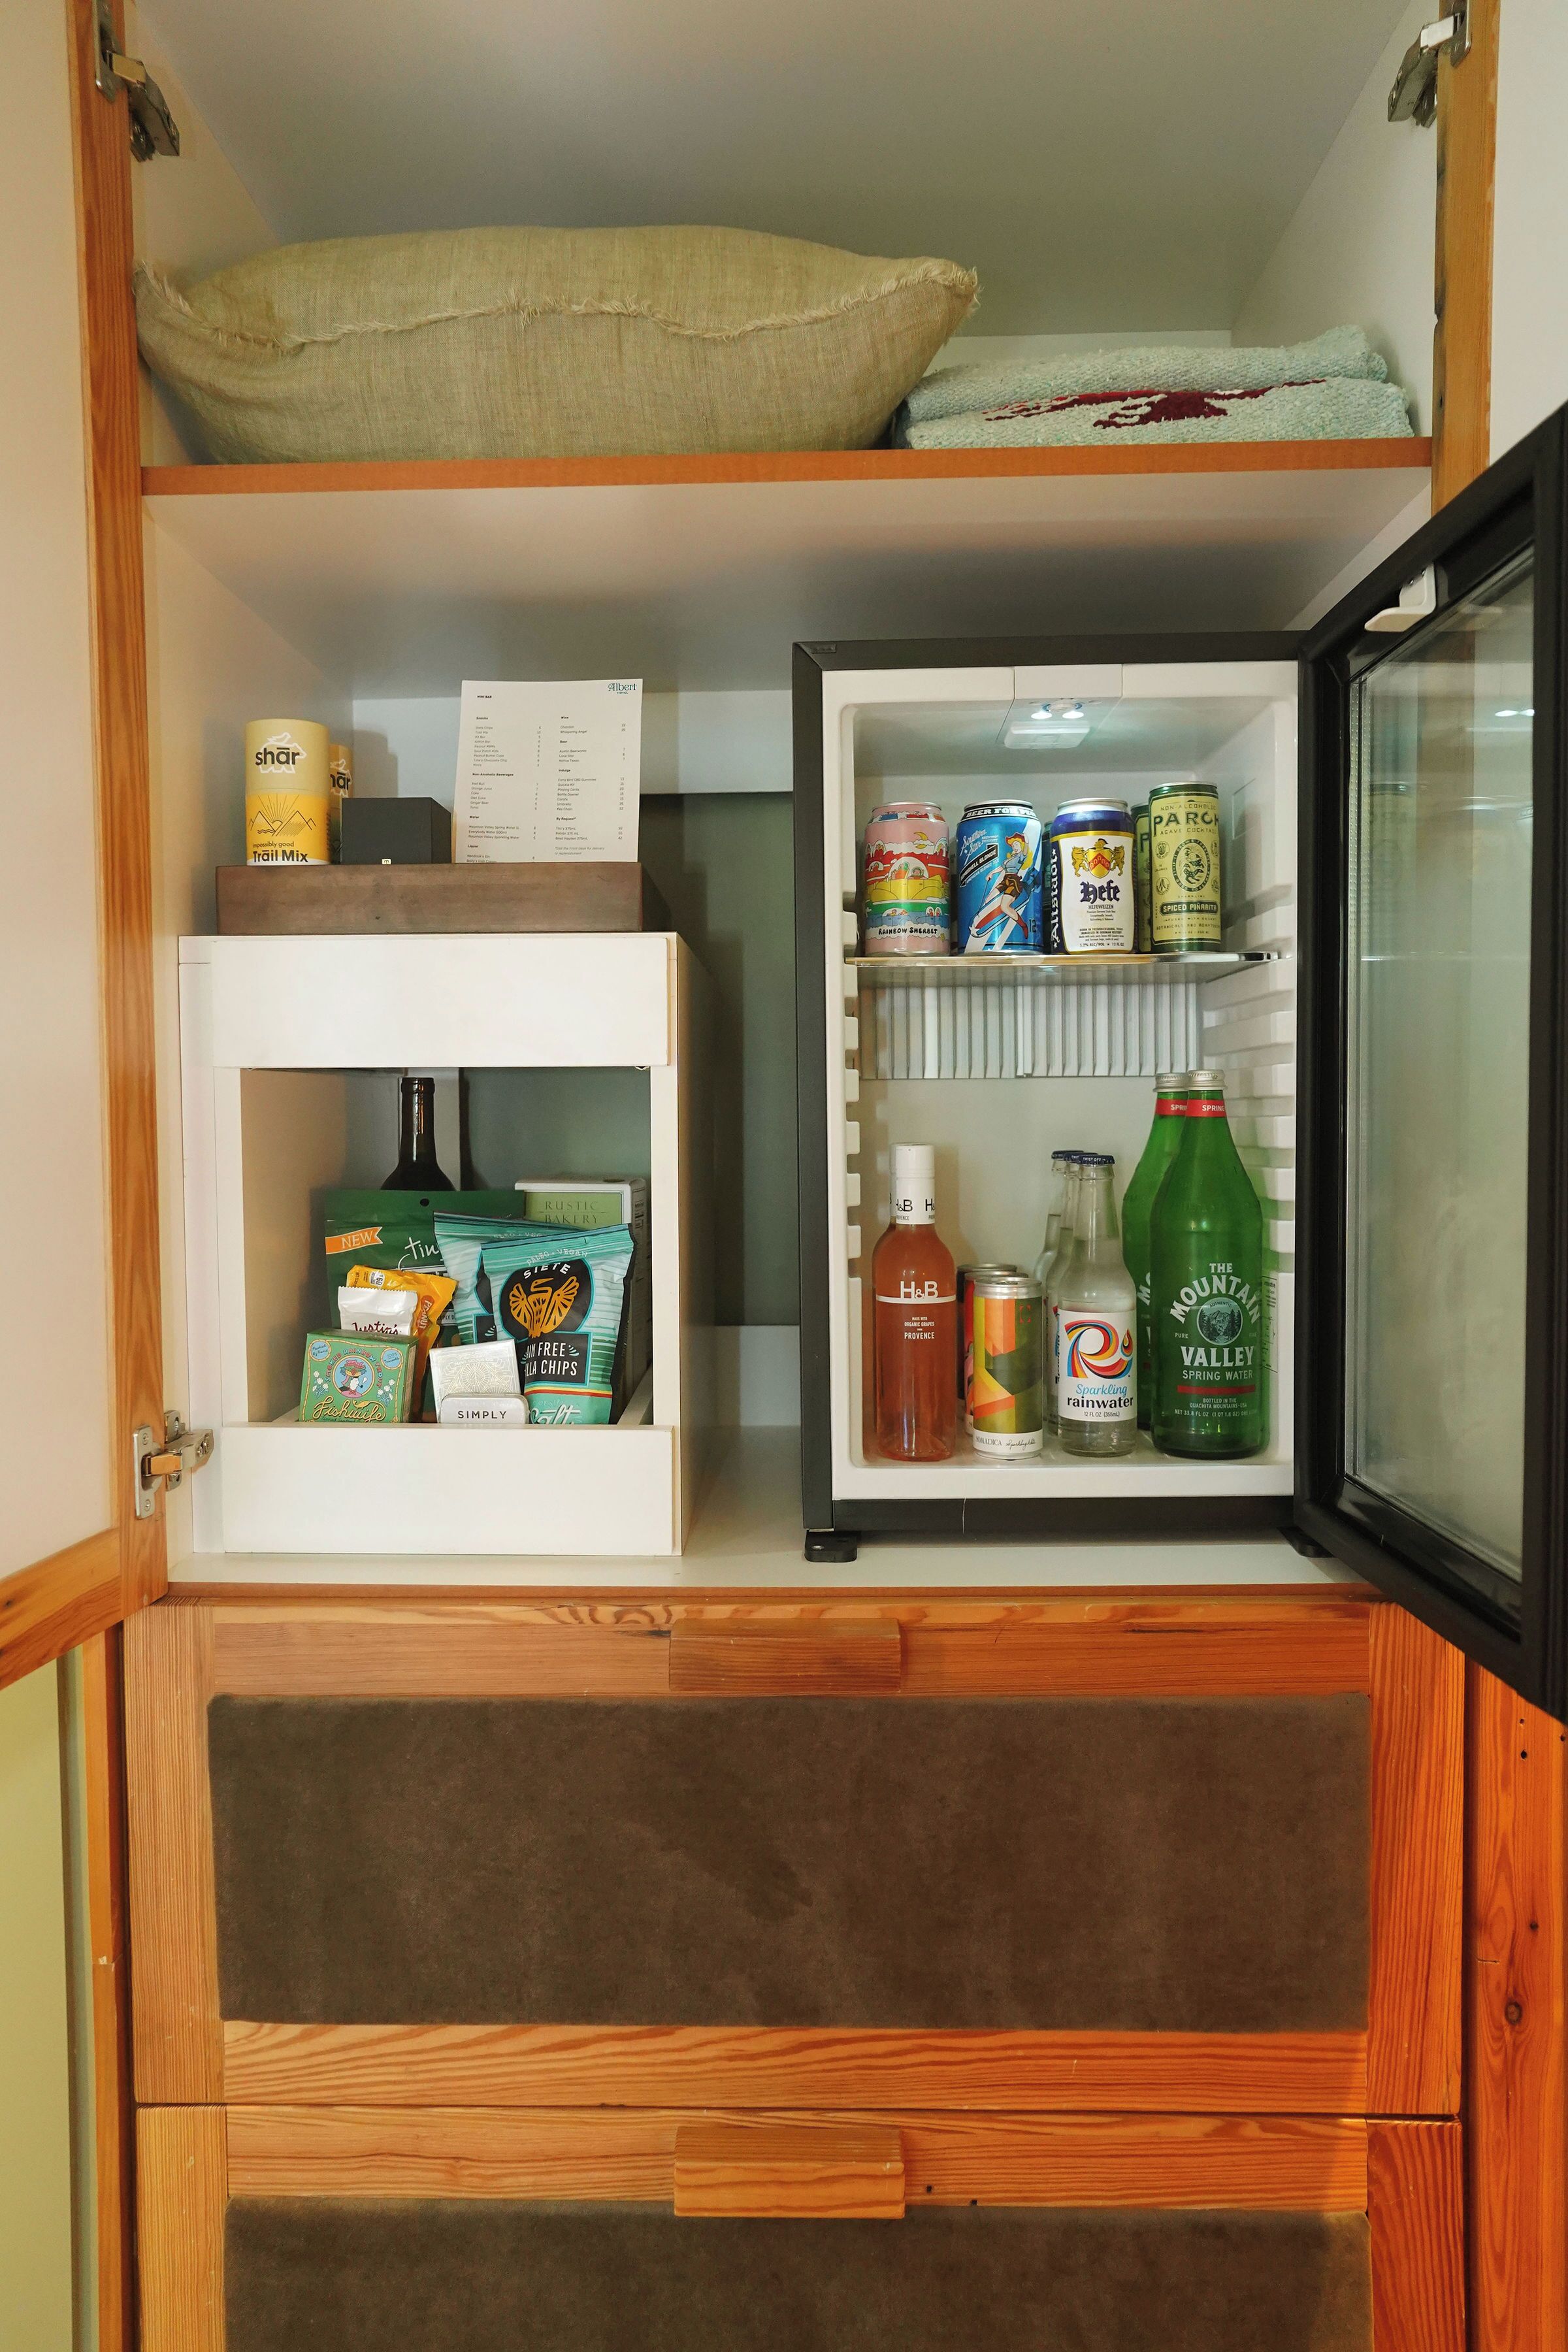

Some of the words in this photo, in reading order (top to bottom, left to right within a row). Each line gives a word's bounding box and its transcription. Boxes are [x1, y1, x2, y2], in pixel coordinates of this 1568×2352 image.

[255, 747, 300, 766] shār
[331, 772, 350, 791] hār
[966, 809, 992, 818] BEER
[253, 850, 278, 863] Trāil
[282, 850, 308, 862] Mix
[979, 849, 996, 864] BLONDE
[1080, 879, 1120, 904] Hefe
[545, 1201, 598, 1210] RUSTIC
[925, 1198, 935, 1212] H&
[545, 1214, 598, 1224] BAKERY
[341, 1231, 373, 1249] NEW
[404, 1237, 440, 1260] tin
[527, 1250, 549, 1266] PALEO
[557, 1249, 588, 1258] VEGAN
[523, 1262, 571, 1279] SIETE
[1209, 1262, 1233, 1273] THE
[900, 1281, 938, 1299] H&B
[1169, 1275, 1260, 1324] MOUNTAIN
[419, 1299, 432, 1329] PEANUT
[526, 1344, 536, 1360] AIN
[538, 1342, 566, 1357] FREE
[1181, 1346, 1254, 1367] VALLEY
[325, 1353, 342, 1382] SMOKED
[343, 1348, 376, 1362] RAINBOW
[541, 1360, 578, 1376] CHIPS
[1183, 1370, 1220, 1380] SPRING
[1226, 1369, 1253, 1380] WATER
[1076, 1384, 1127, 1397] Sparkling
[313, 1396, 385, 1422] Fishwife
[1068, 1396, 1134, 1409] rainwater
[457, 1411, 508, 1420] SIMPLY
